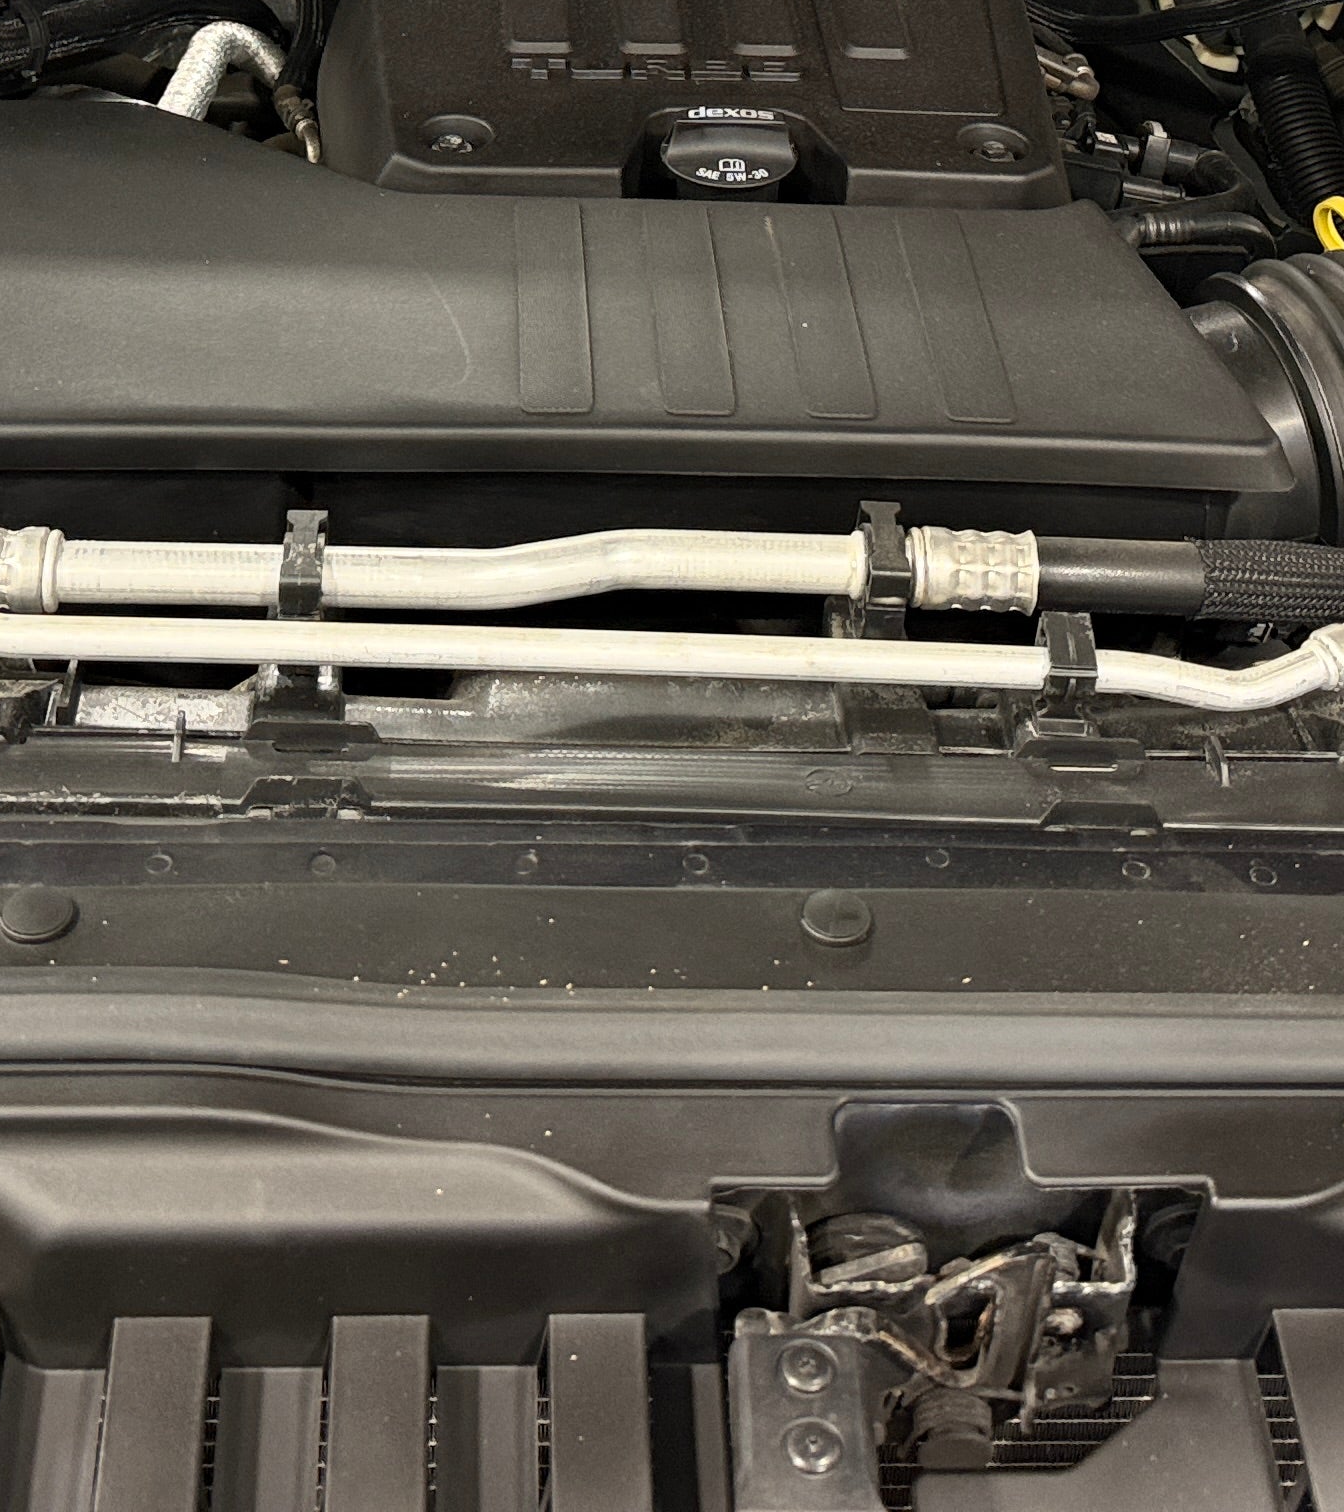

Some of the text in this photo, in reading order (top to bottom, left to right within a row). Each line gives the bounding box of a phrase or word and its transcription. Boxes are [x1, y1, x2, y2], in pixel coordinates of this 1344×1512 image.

[688, 106, 775, 120] dexos
[696, 168, 769, 182] SAE 5W-30
